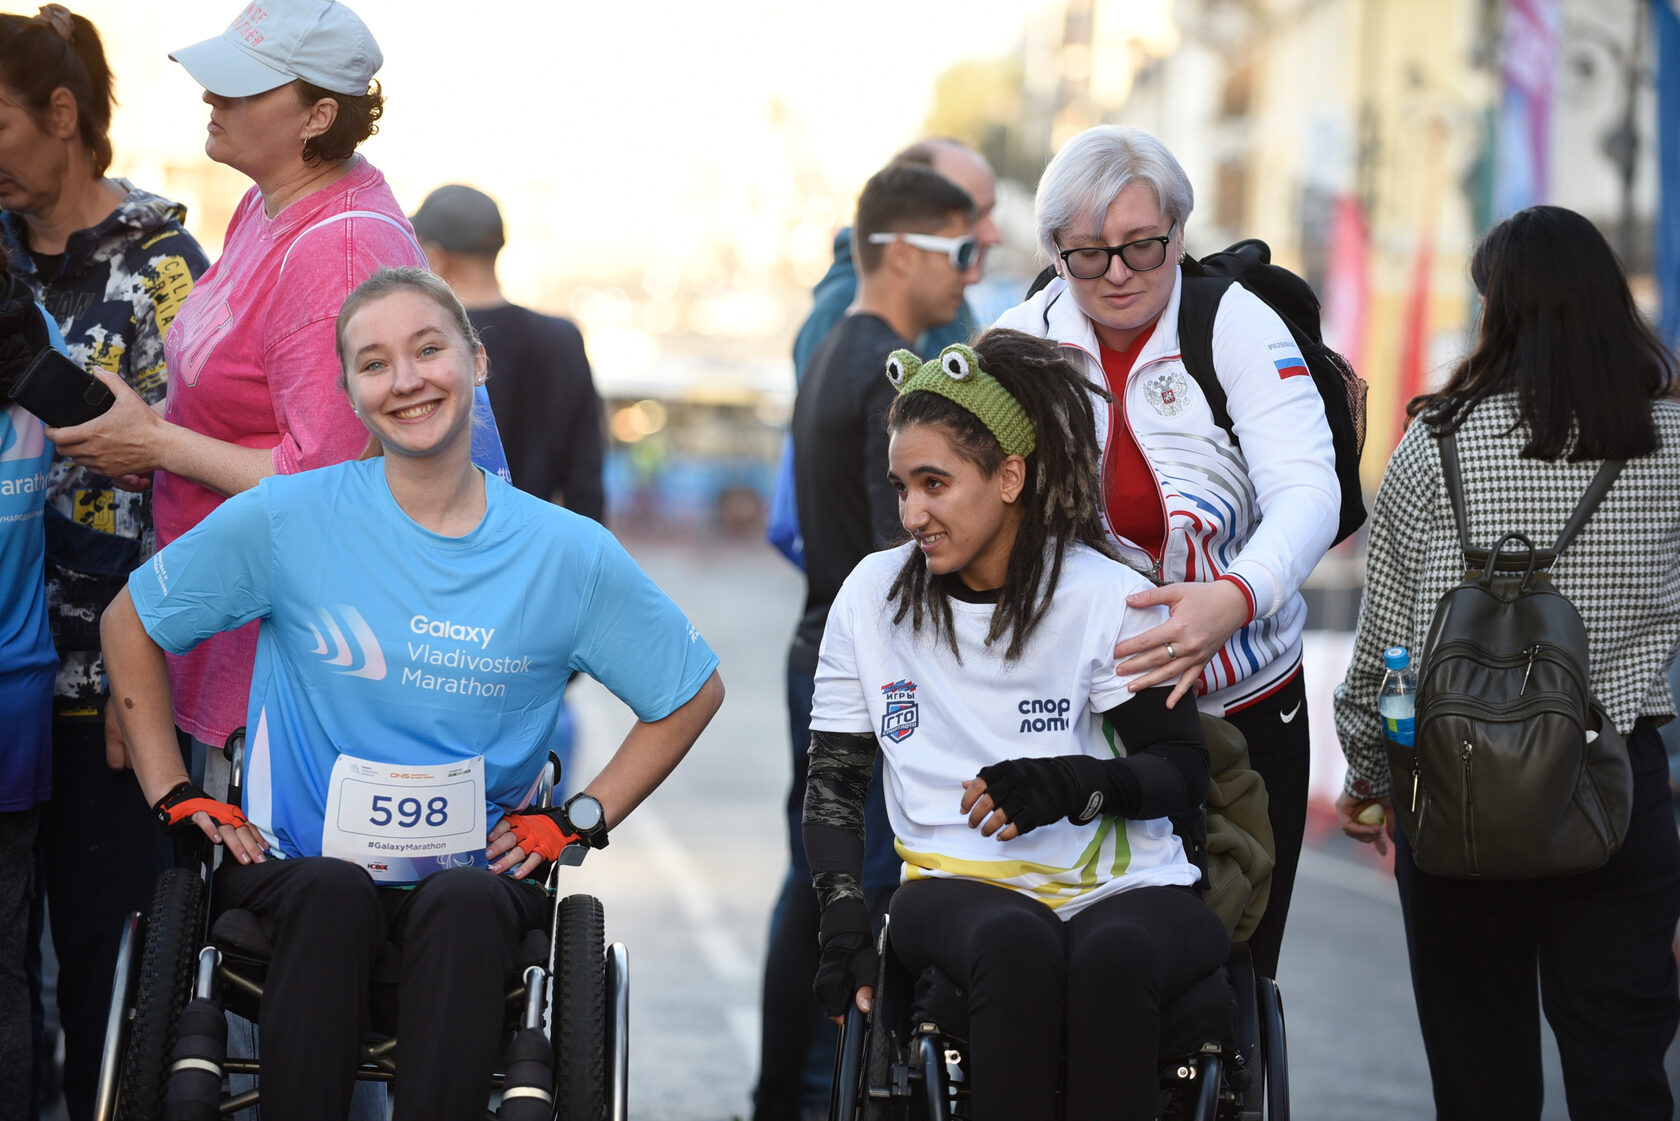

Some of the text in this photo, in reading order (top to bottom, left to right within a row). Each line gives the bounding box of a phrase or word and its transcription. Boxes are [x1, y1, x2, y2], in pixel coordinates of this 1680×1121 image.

[410, 615, 495, 650] Galaxy
[408, 641, 532, 674] Vladivostok
[402, 667, 506, 697] Marathon
[886, 692, 915, 700] ИГРЫ
[886, 709, 914, 729] ГТО
[369, 795, 448, 828] 598
[367, 841, 447, 851] #GalaxyMarathon
